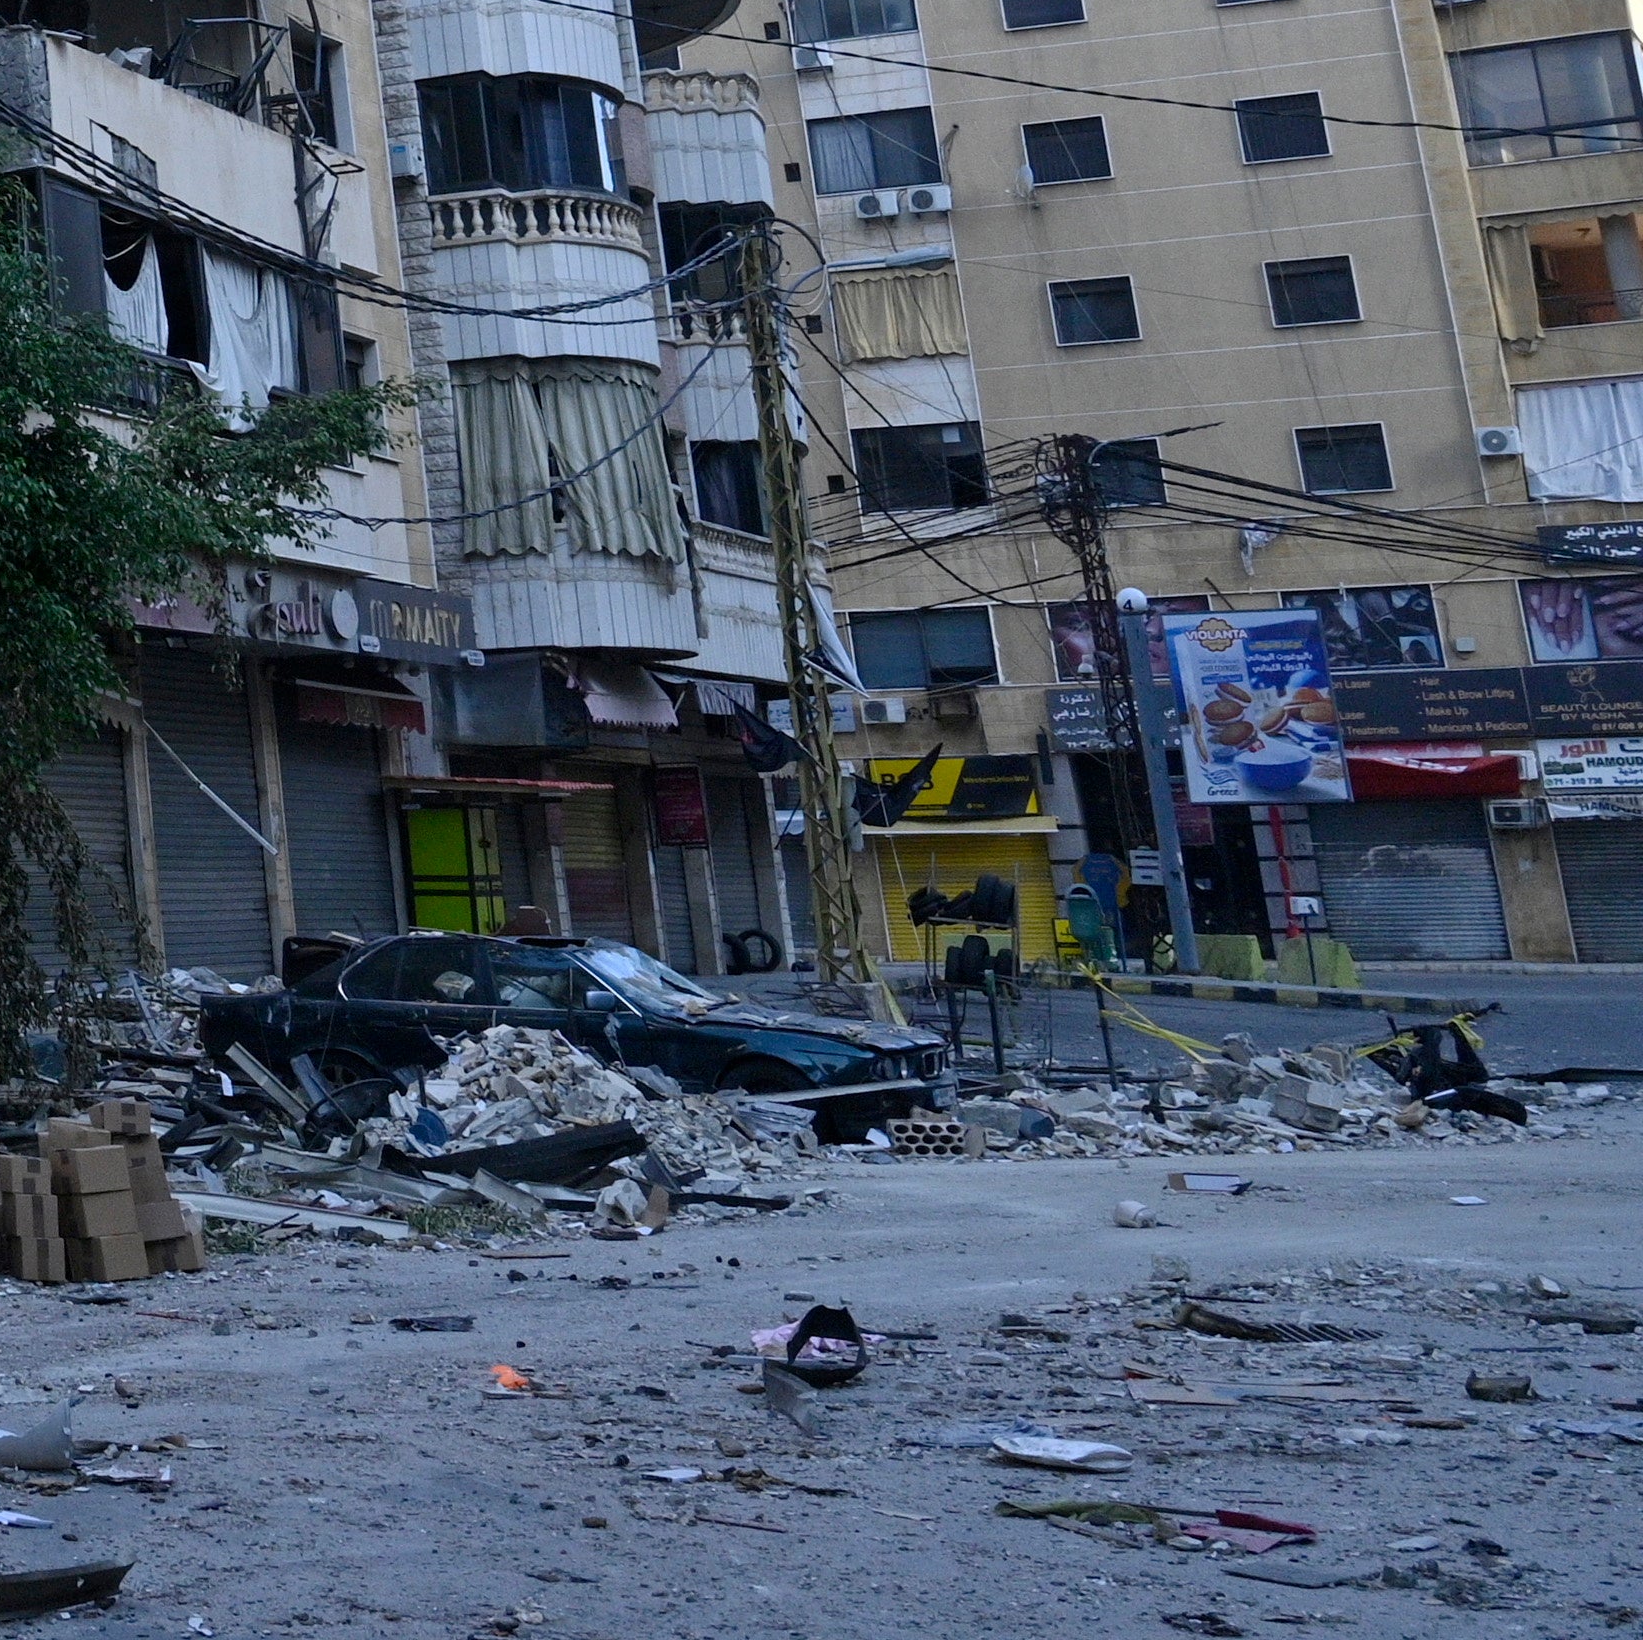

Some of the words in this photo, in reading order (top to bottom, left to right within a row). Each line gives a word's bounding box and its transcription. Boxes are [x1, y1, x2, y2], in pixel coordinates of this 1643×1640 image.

[1184, 628, 1249, 641] VIOLANTA
[1422, 691, 1446, 701] Lash
[1458, 689, 1483, 700] Brow
[1485, 688, 1515, 700] Lifting
[1540, 703, 1588, 713] BEAUTY
[1591, 701, 1643, 712] LOUNGE
[1561, 712, 1578, 721] BY
[1581, 711, 1626, 720] RASHA
[1428, 722, 1473, 733] Manicure
[1485, 720, 1529, 732] Pedicure
[1559, 739, 1608, 758] النور
[1207, 786, 1240, 798] Greece
